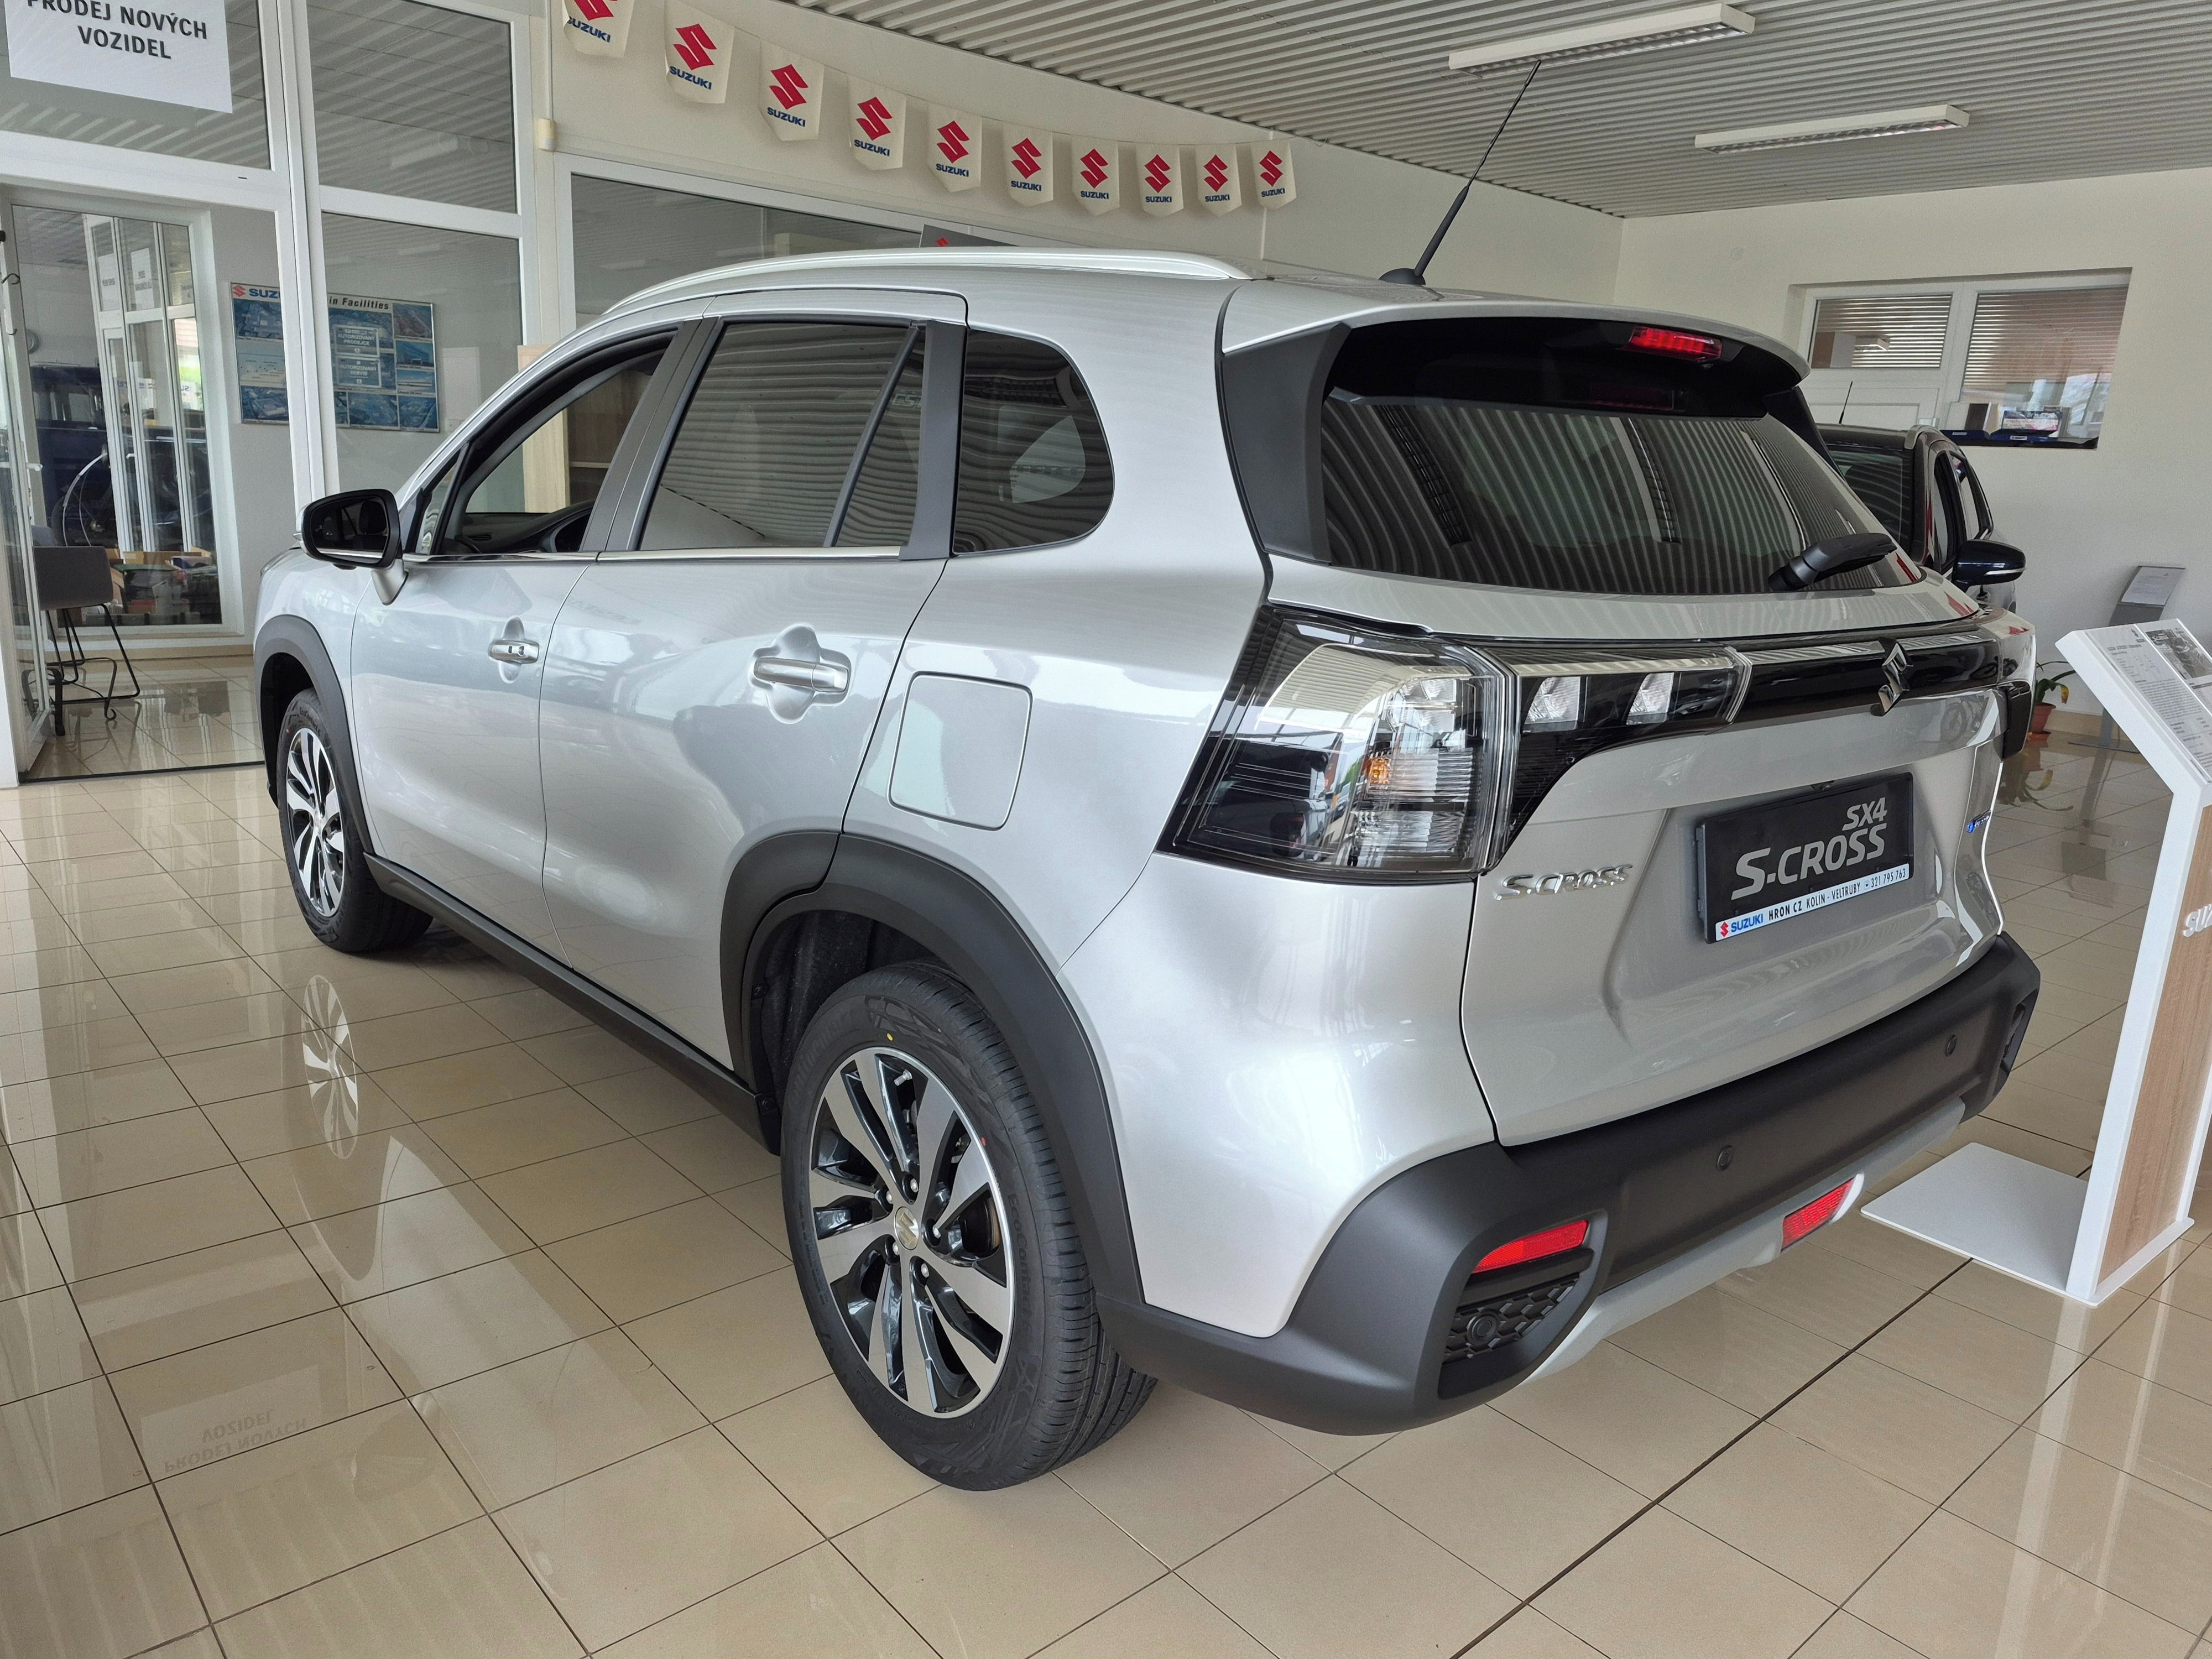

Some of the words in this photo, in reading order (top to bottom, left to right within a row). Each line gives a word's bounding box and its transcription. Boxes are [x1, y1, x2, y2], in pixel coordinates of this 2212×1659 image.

[120, 6, 207, 39] NOVÝCH
[77, 25, 172, 59] VOZIDEL
[670, 66, 712, 90] SUZUKI
[767, 107, 806, 127] SUZUKI
[854, 139, 890, 156] SUZUKI
[936, 163, 969, 177] SUZUKI
[1010, 180, 1042, 191] SUZUKI
[1261, 187, 1286, 197] SUZUKI
[1080, 190, 1109, 200] SUZUKI
[1204, 194, 1230, 202] SUZUKI
[342, 297, 389, 310] Facilities
[1842, 796, 1888, 831] SX4
[1731, 913, 1764, 933] SUZUKI
[1768, 904, 1791, 921] HRON
[1793, 900, 1803, 913] CZ
[1806, 891, 1825, 909] KOLÍN
[1831, 881, 1861, 900] VELTRUBY
[1871, 875, 1881, 888] 321
[1883, 872, 1894, 884] 795
[1895, 868, 1906, 880] 763
